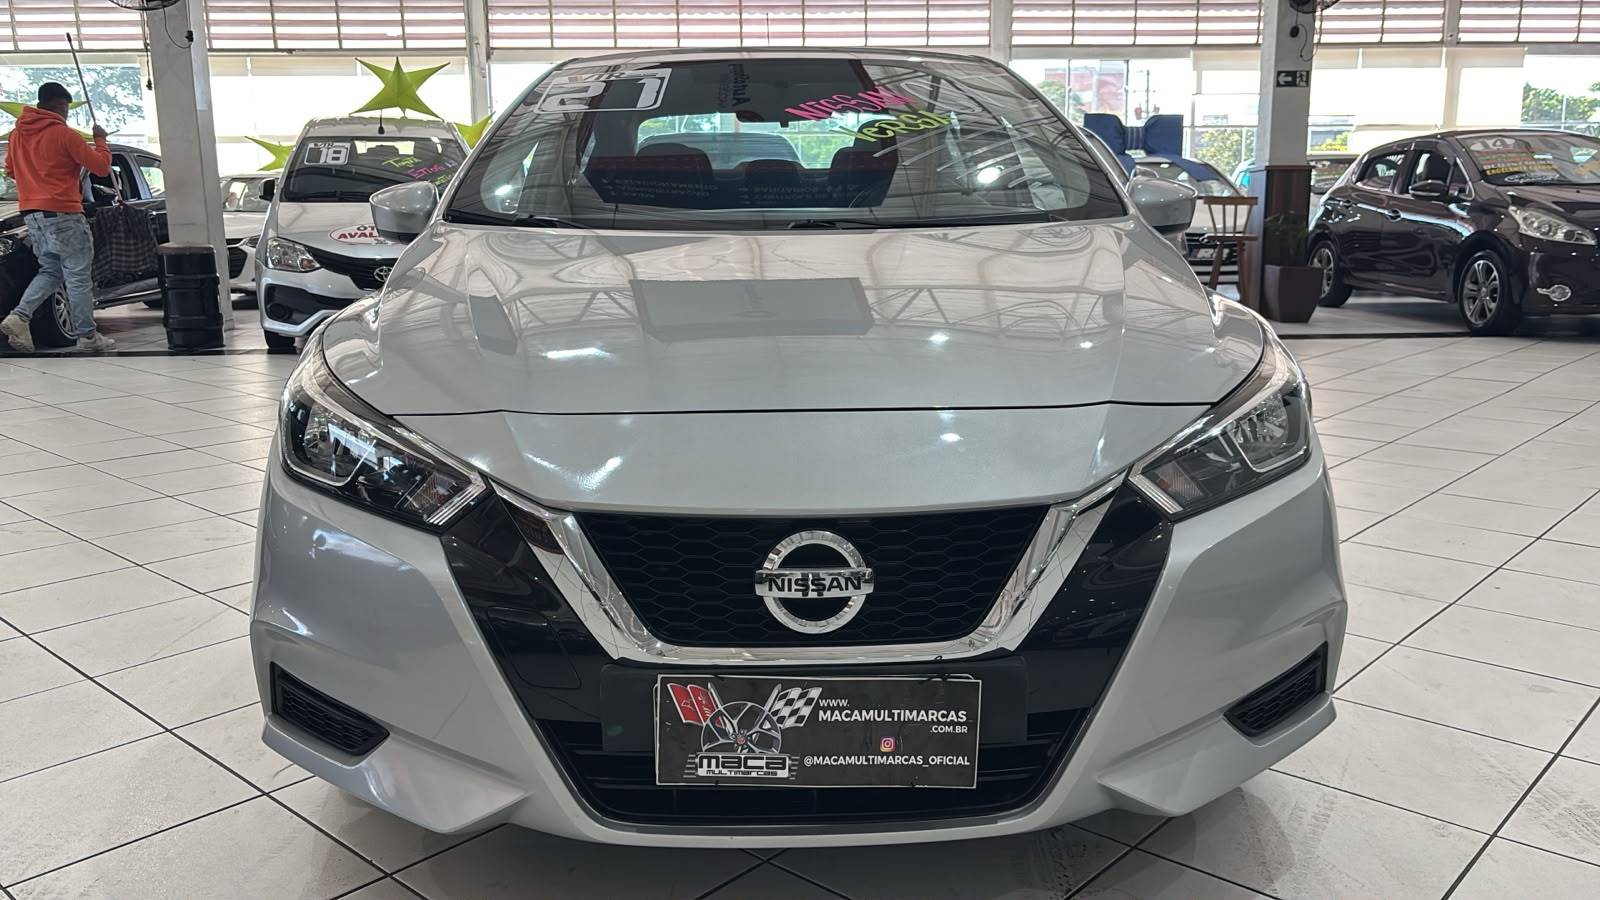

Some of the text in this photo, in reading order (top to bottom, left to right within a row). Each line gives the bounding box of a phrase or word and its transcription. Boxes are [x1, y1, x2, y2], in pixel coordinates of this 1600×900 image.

[319, 147, 348, 164] 18
[337, 231, 377, 240] AVAL
[768, 577, 862, 593] NISSAN
[818, 709, 968, 722] MACAMULTIMARCAS
[930, 725, 968, 734] .COM.BR
[803, 755, 971, 767] @MACAMULTIMARCAS_OFICIAL
